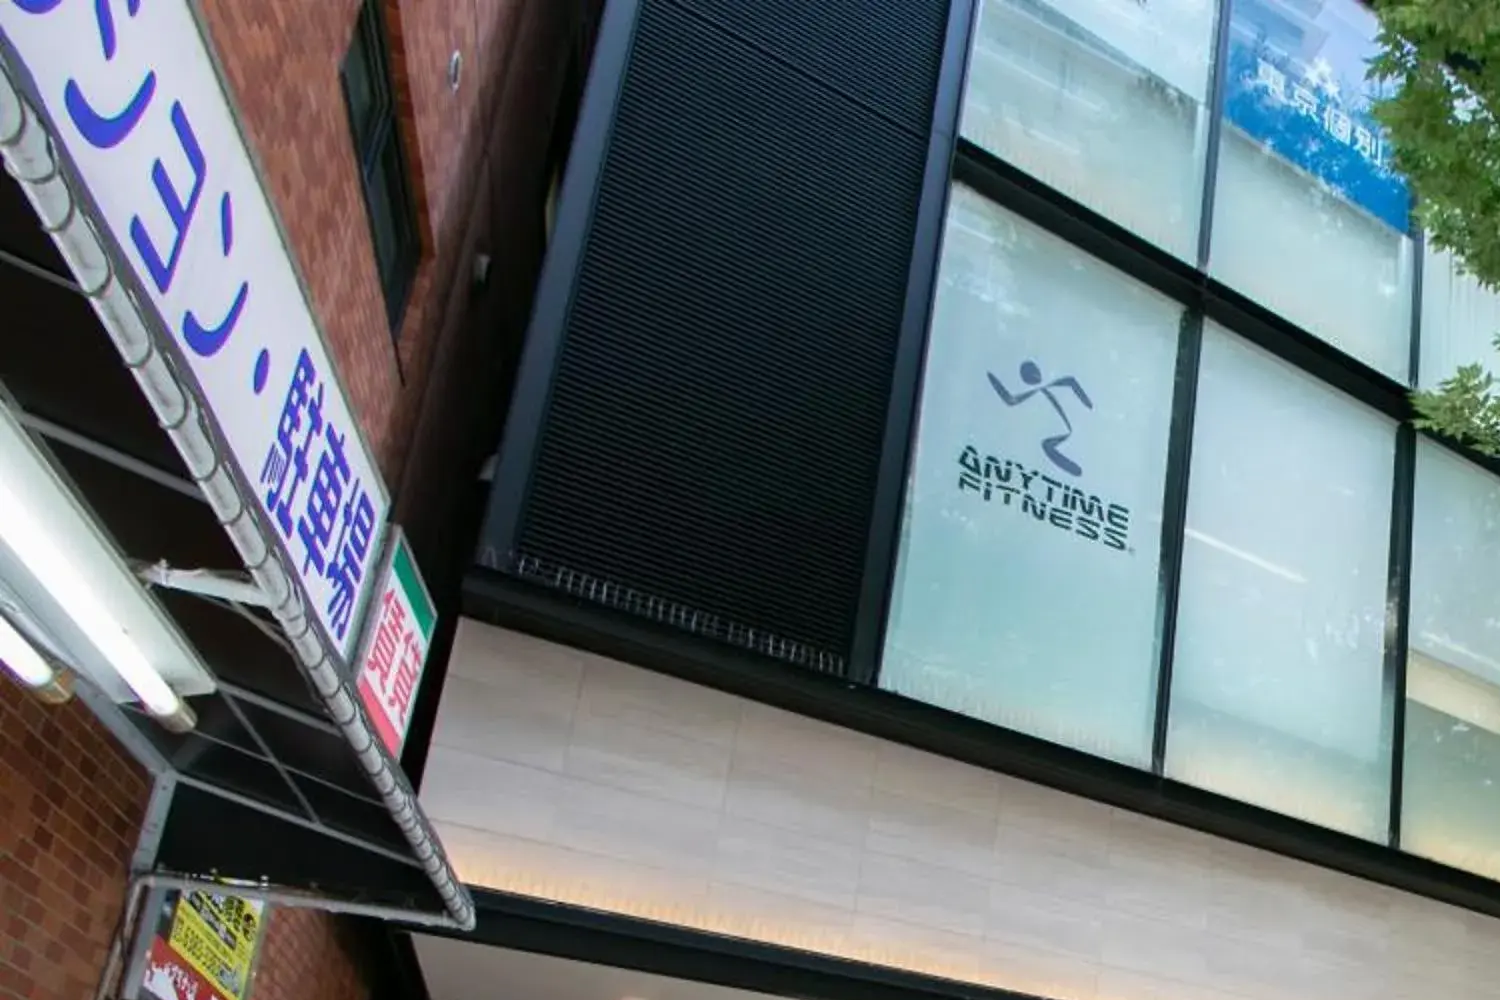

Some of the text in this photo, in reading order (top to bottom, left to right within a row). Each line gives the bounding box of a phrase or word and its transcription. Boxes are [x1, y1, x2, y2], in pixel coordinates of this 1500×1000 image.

[10, 0, 376, 640] ション・駐車場
[958, 445, 1130, 531] ANYTIME
[958, 471, 1128, 551] FITNESS
